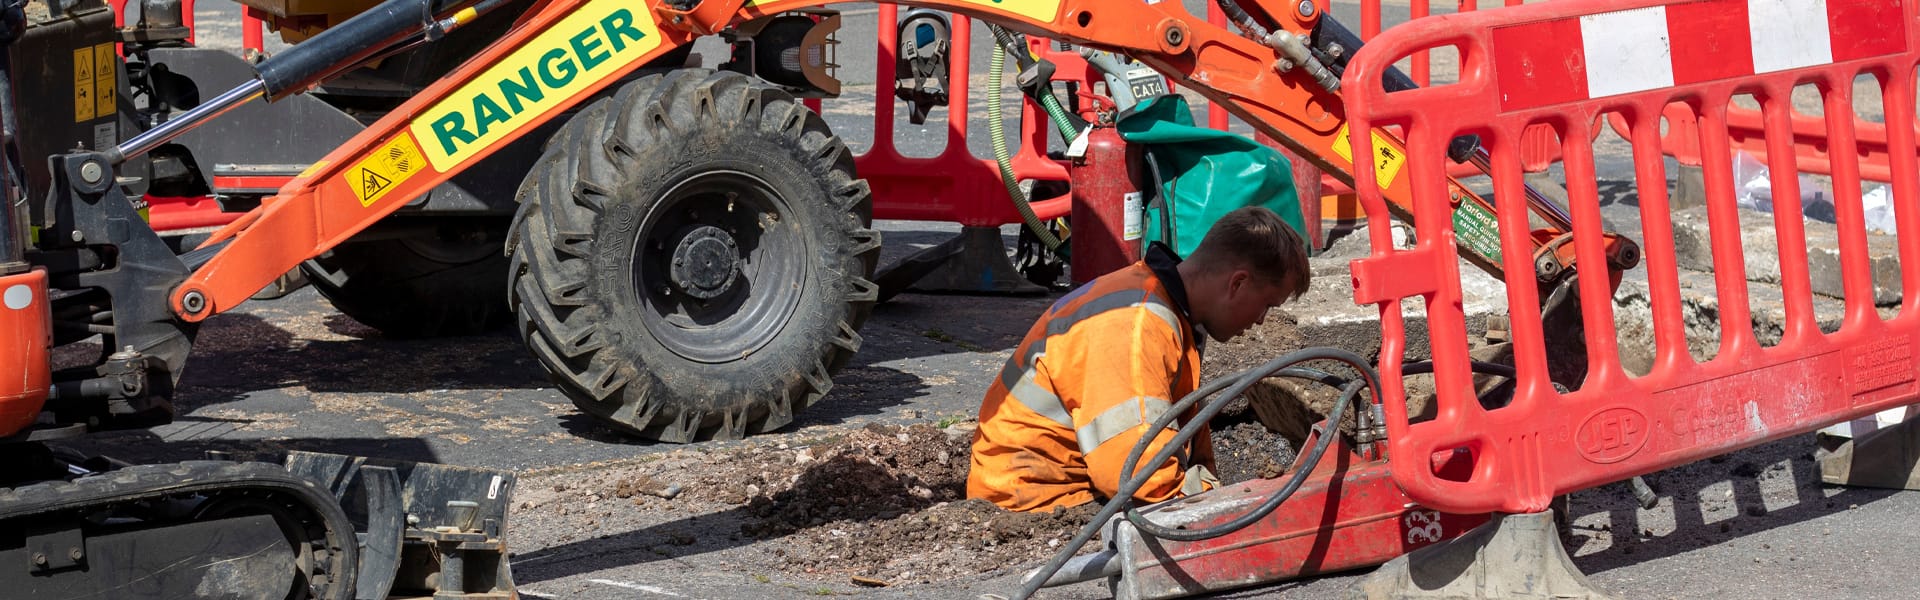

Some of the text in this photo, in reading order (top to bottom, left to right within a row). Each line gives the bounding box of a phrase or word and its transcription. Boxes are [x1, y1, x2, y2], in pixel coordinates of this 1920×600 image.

[430, 8, 646, 156] RANGER
[1457, 209, 1479, 229] MANUAL
[1459, 219, 1480, 236] SAFETY
[1490, 241, 1502, 253] NOT
[1464, 231, 1491, 254] REQUIRED
[1586, 413, 1639, 454] JSP
